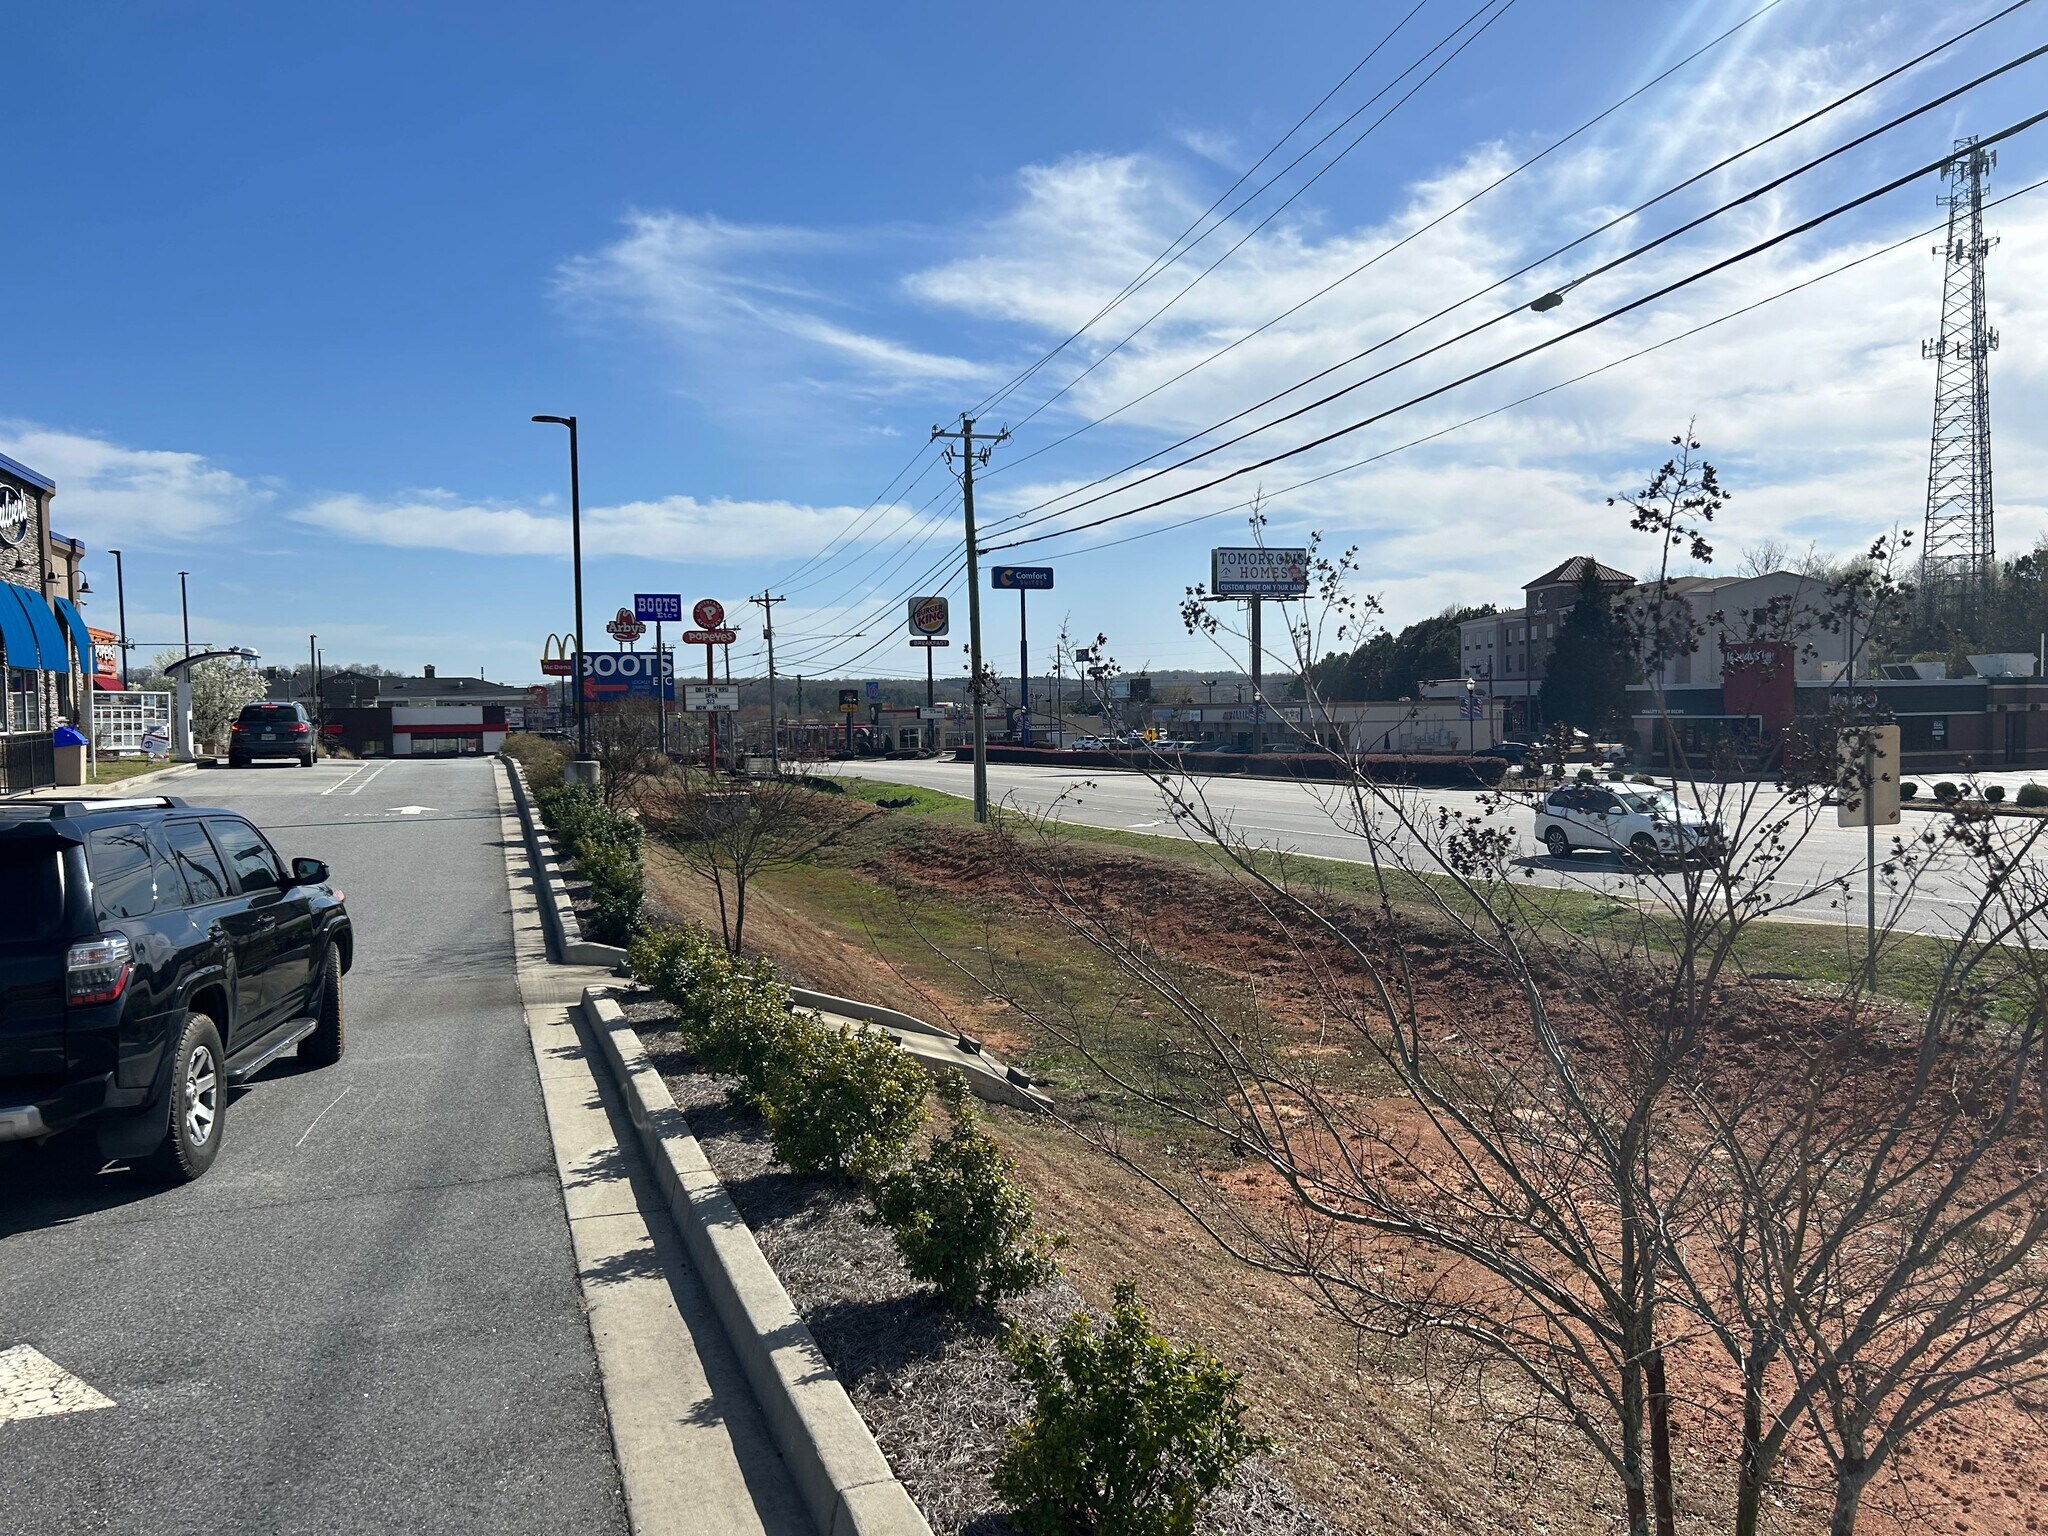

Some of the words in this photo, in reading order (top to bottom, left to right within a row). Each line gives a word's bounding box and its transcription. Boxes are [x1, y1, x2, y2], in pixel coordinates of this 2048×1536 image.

[0, 488, 27, 528] ulver's
[1016, 571, 1047, 579] Comfort
[1240, 567, 1288, 579] HOMES
[638, 598, 678, 612] BOOTS
[917, 604, 943, 617] BURGER
[918, 611, 945, 626] KING
[608, 622, 645, 634] Arby's
[583, 655, 672, 677] BOOTS
